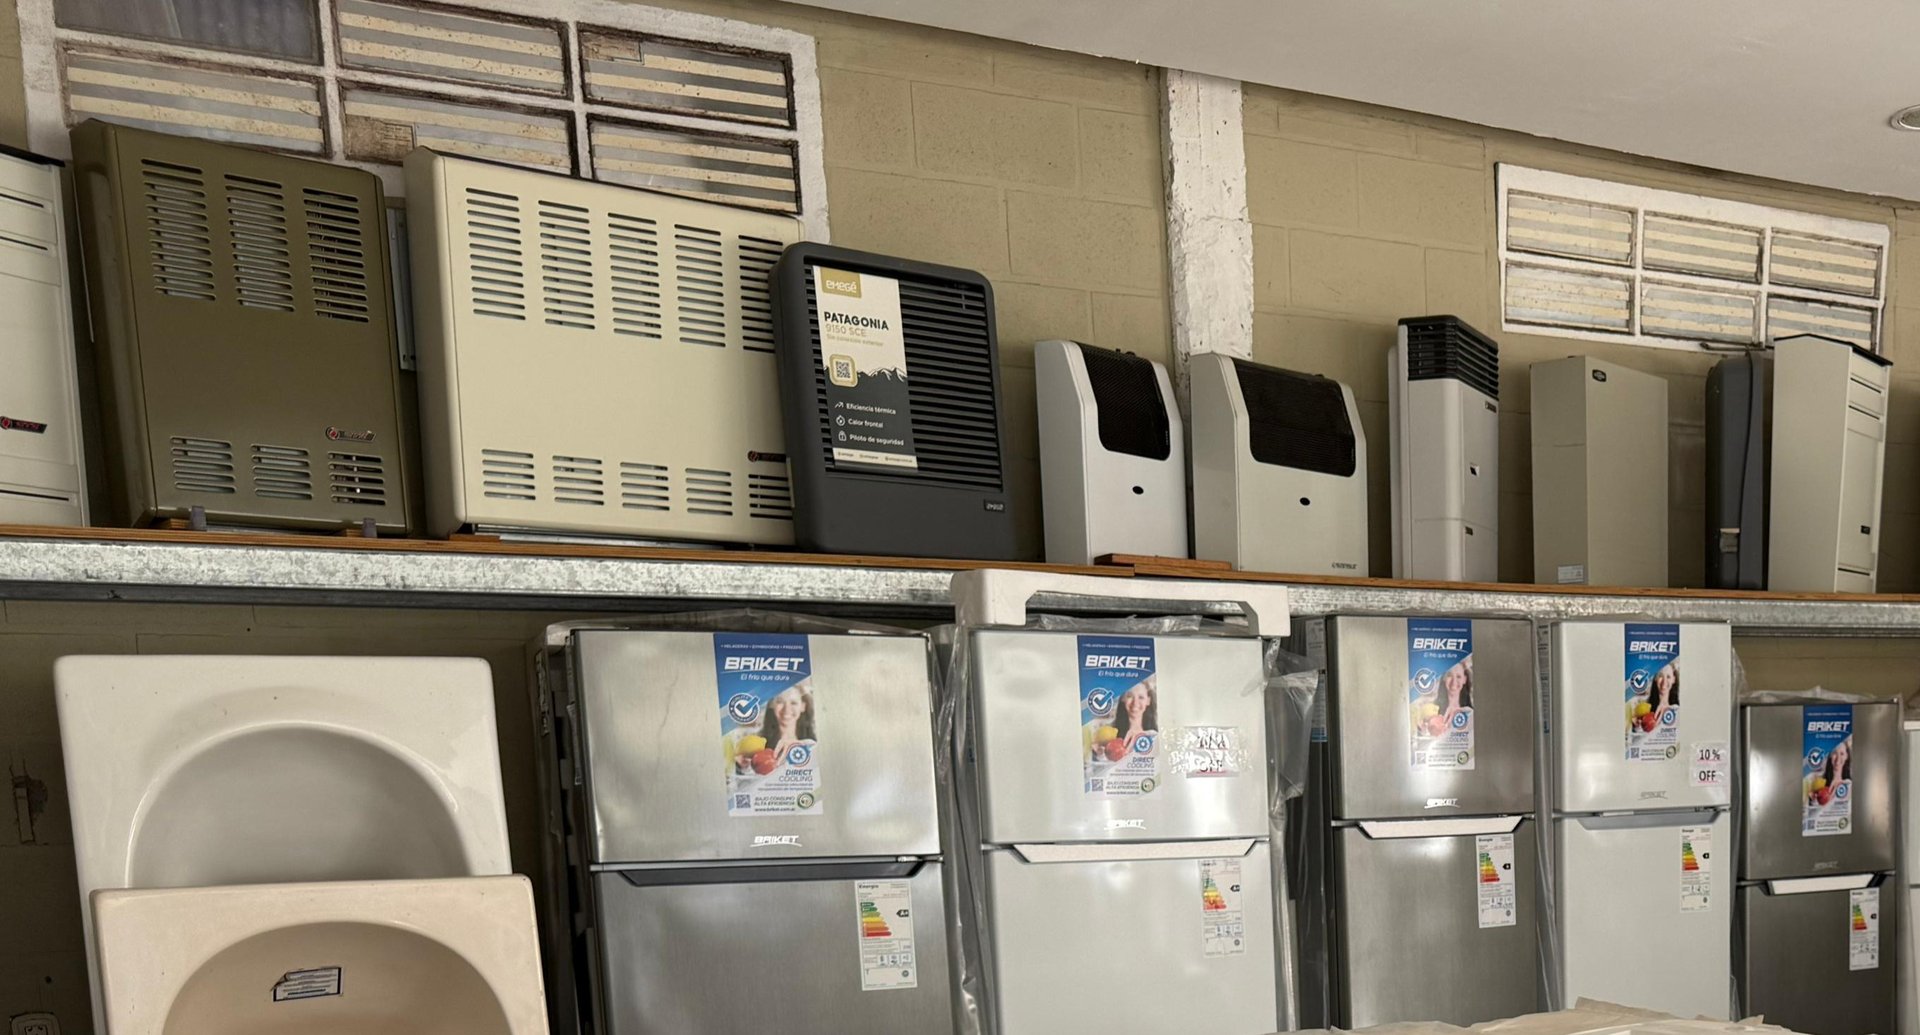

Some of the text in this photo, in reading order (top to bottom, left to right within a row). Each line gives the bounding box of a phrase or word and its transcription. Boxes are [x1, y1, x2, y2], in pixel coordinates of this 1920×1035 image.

[824, 311, 889, 330] PATAGONIA
[825, 324, 867, 336] 9150 SCE
[846, 402, 874, 412] Eficiencia
[864, 420, 884, 428] frontal
[849, 434, 867, 442] Piloto
[876, 438, 904, 446] seguridad
[1412, 638, 1468, 650] BRIKET
[1630, 640, 1677, 652] BRIKET
[724, 656, 804, 671] BRIKET
[1085, 654, 1151, 668] BRIKET
[1807, 721, 1850, 732] BRIKET
[1700, 749, 1720, 760] 10 %
[1699, 770, 1716, 781] OFF
[754, 835, 799, 844] BRIKET
